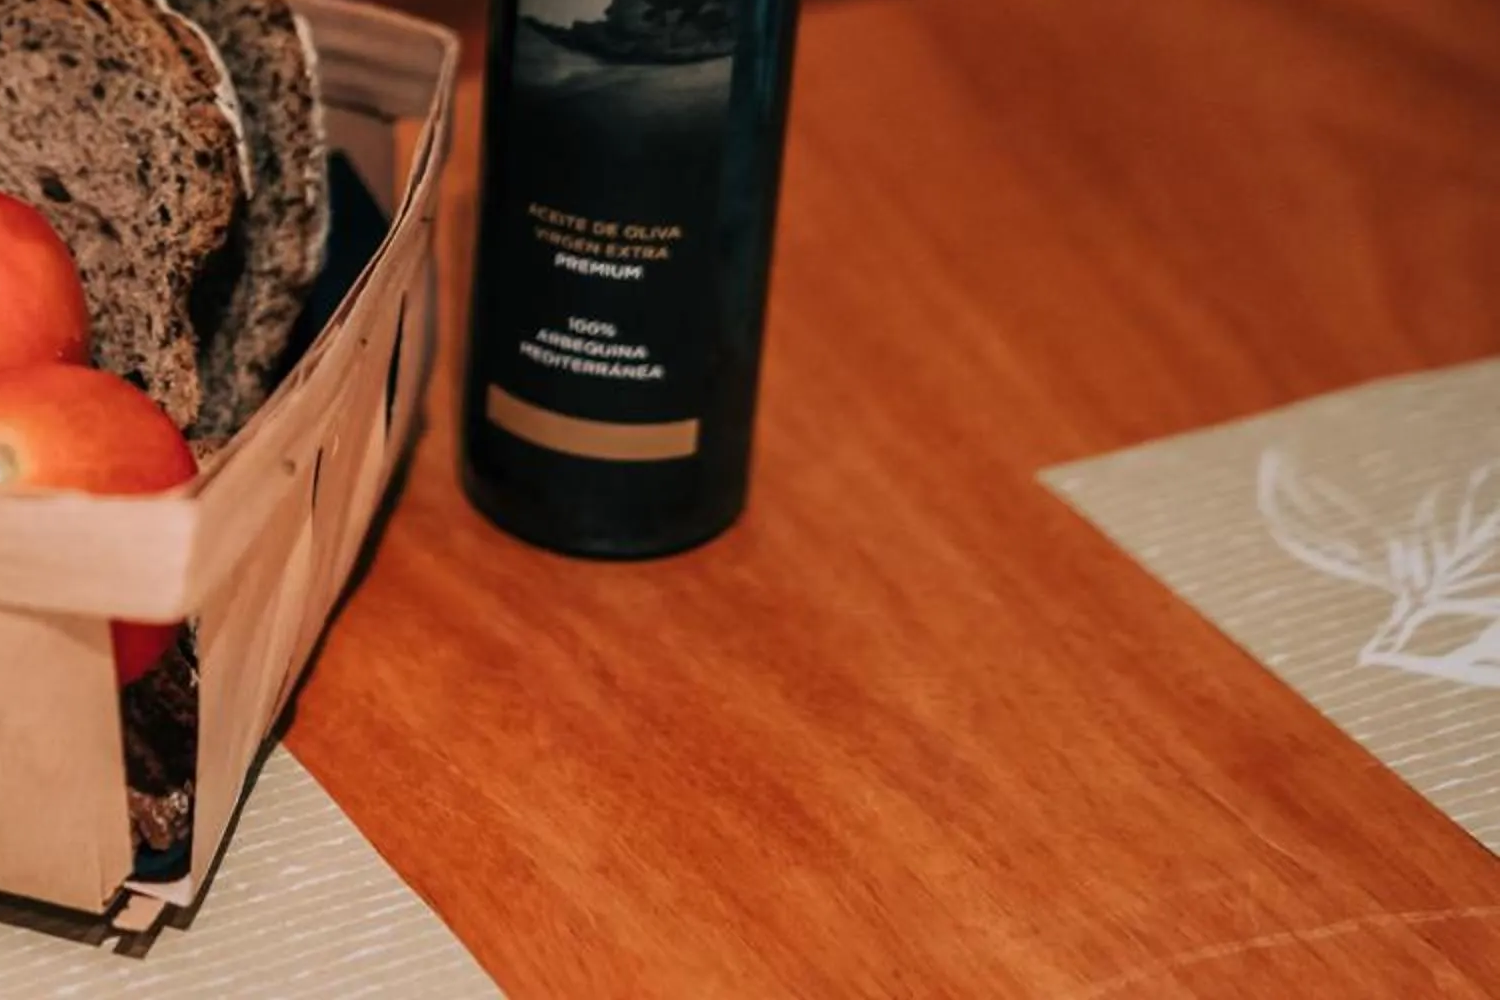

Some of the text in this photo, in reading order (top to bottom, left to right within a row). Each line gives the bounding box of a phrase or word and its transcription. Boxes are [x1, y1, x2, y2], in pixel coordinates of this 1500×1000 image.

[528, 202, 682, 241] ACEITE DE OLIVA
[534, 227, 671, 261] VIRGEN EXTRA
[555, 253, 642, 280] PREMIUM
[567, 315, 617, 339] 100%
[536, 329, 647, 359] ARBEQUINA
